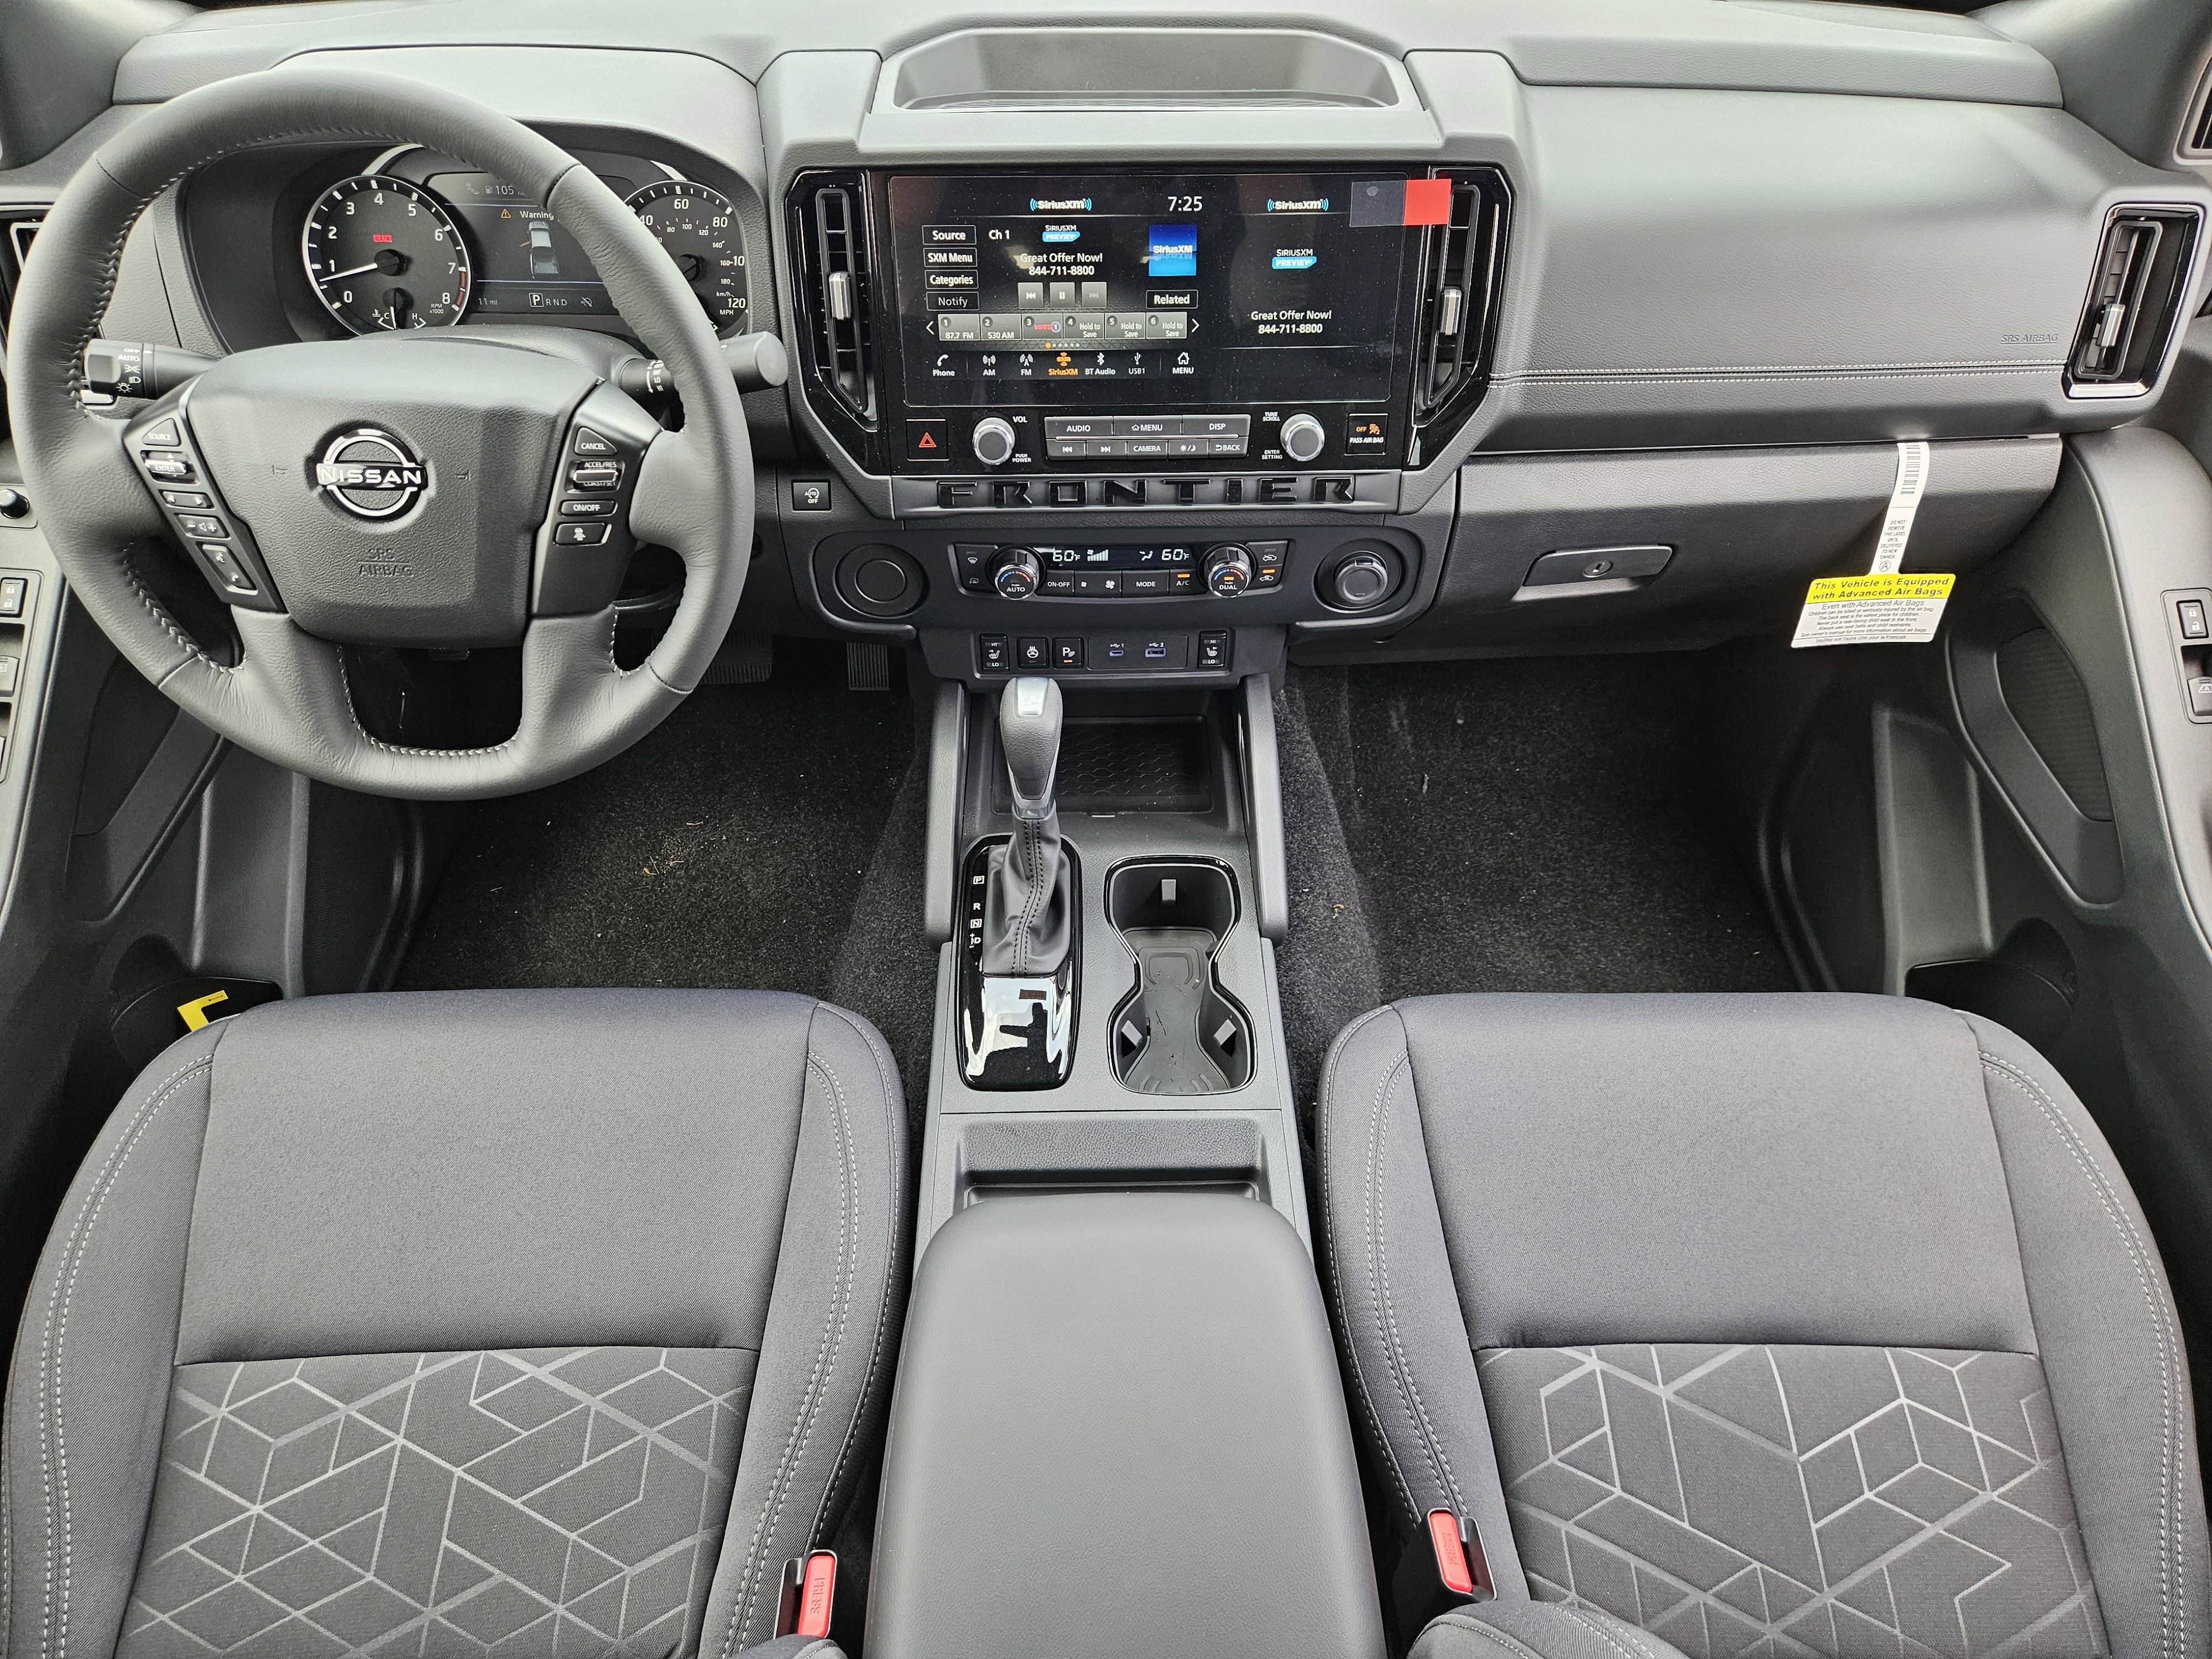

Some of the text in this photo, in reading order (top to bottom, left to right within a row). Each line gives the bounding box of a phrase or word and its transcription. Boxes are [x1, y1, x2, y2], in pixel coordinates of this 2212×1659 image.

[495, 186, 514, 195] 105
[374, 192, 384, 205] 4
[674, 199, 689, 209] 60
[1168, 196, 1203, 211] 7:25
[346, 202, 355, 215] 3
[408, 204, 416, 216] 5
[519, 211, 554, 220] Warning
[713, 217, 728, 228] 80
[328, 226, 337, 239] 2
[435, 229, 443, 241] 6
[932, 230, 966, 240] Source
[989, 229, 1010, 240] Ch 1
[928, 252, 973, 263] SXM Menu
[1020, 252, 1103, 263] Great Offer Now!
[448, 262, 456, 274] 7
[1029, 265, 1095, 275] 844-711-8800
[930, 274, 973, 286] Categories
[343, 291, 352, 303] 0
[442, 293, 450, 304] 8
[938, 296, 968, 307] Notify
[1154, 294, 1190, 304] Related
[728, 298, 746, 309] 120
[1251, 310, 1332, 320] Great Offer Now!
[1258, 324, 1323, 334] 844-711-8800
[319, 469, 422, 484] NISSAN
[937, 476, 1355, 508] FRONTIER
[1815, 581, 1836, 590] This
[1841, 580, 1879, 588] Vehicle
[1897, 578, 1949, 587] Equipped
[1813, 592, 1835, 600] with
[1838, 588, 1892, 598] Advanced
[1914, 588, 1943, 597] Bags
